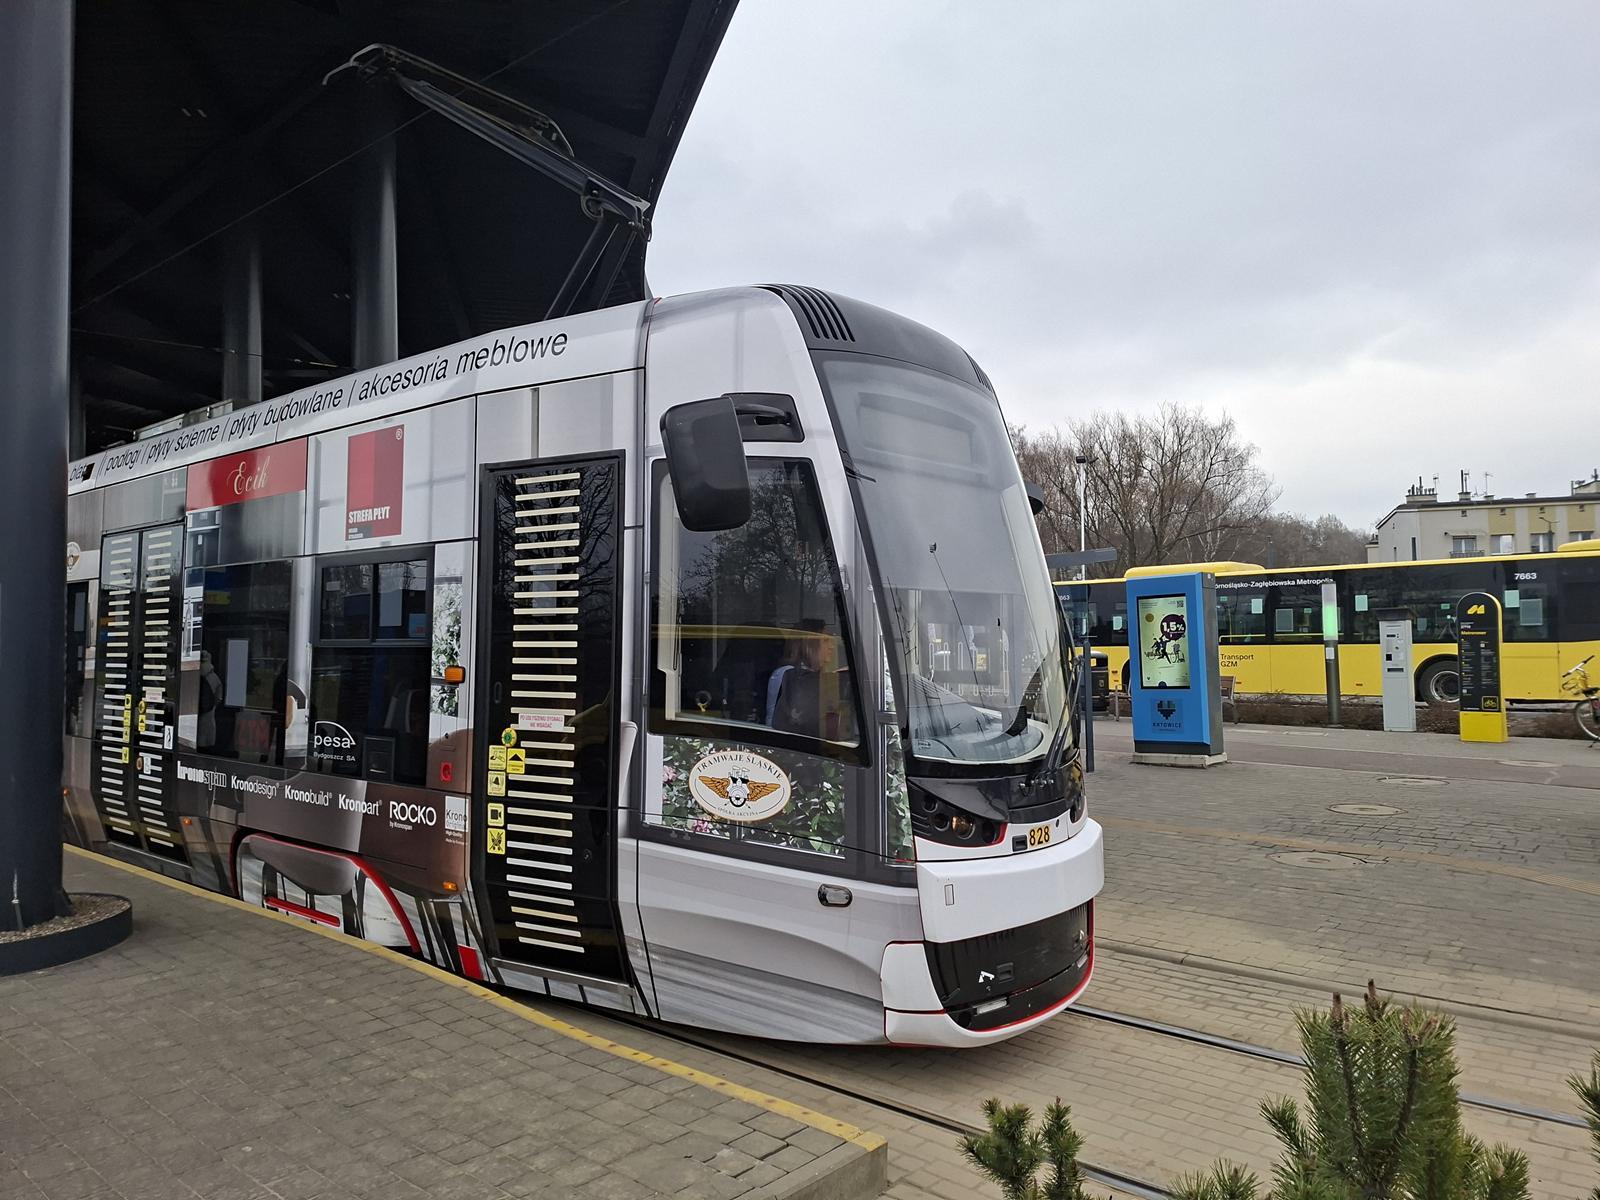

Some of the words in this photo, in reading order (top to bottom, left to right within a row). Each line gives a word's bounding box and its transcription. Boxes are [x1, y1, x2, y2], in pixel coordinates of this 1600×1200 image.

[105, 448, 141, 474] podłogi
[147, 440, 174, 463] płyty
[174, 425, 220, 451] ścienne
[228, 411, 262, 441] płyty
[263, 388, 343, 426] budowlane
[358, 355, 449, 401] akcesoria
[455, 332, 568, 375] meblowe
[348, 508, 373, 524] STREFA
[373, 506, 391, 521] PŁYT
[1514, 572, 1537, 580] 7663
[314, 735, 351, 749] pesa
[314, 752, 344, 761] Bydgoszcz
[697, 754, 745, 773] TRAMWAJE
[389, 800, 437, 826] ROCKO
[1029, 826, 1050, 846] 828
